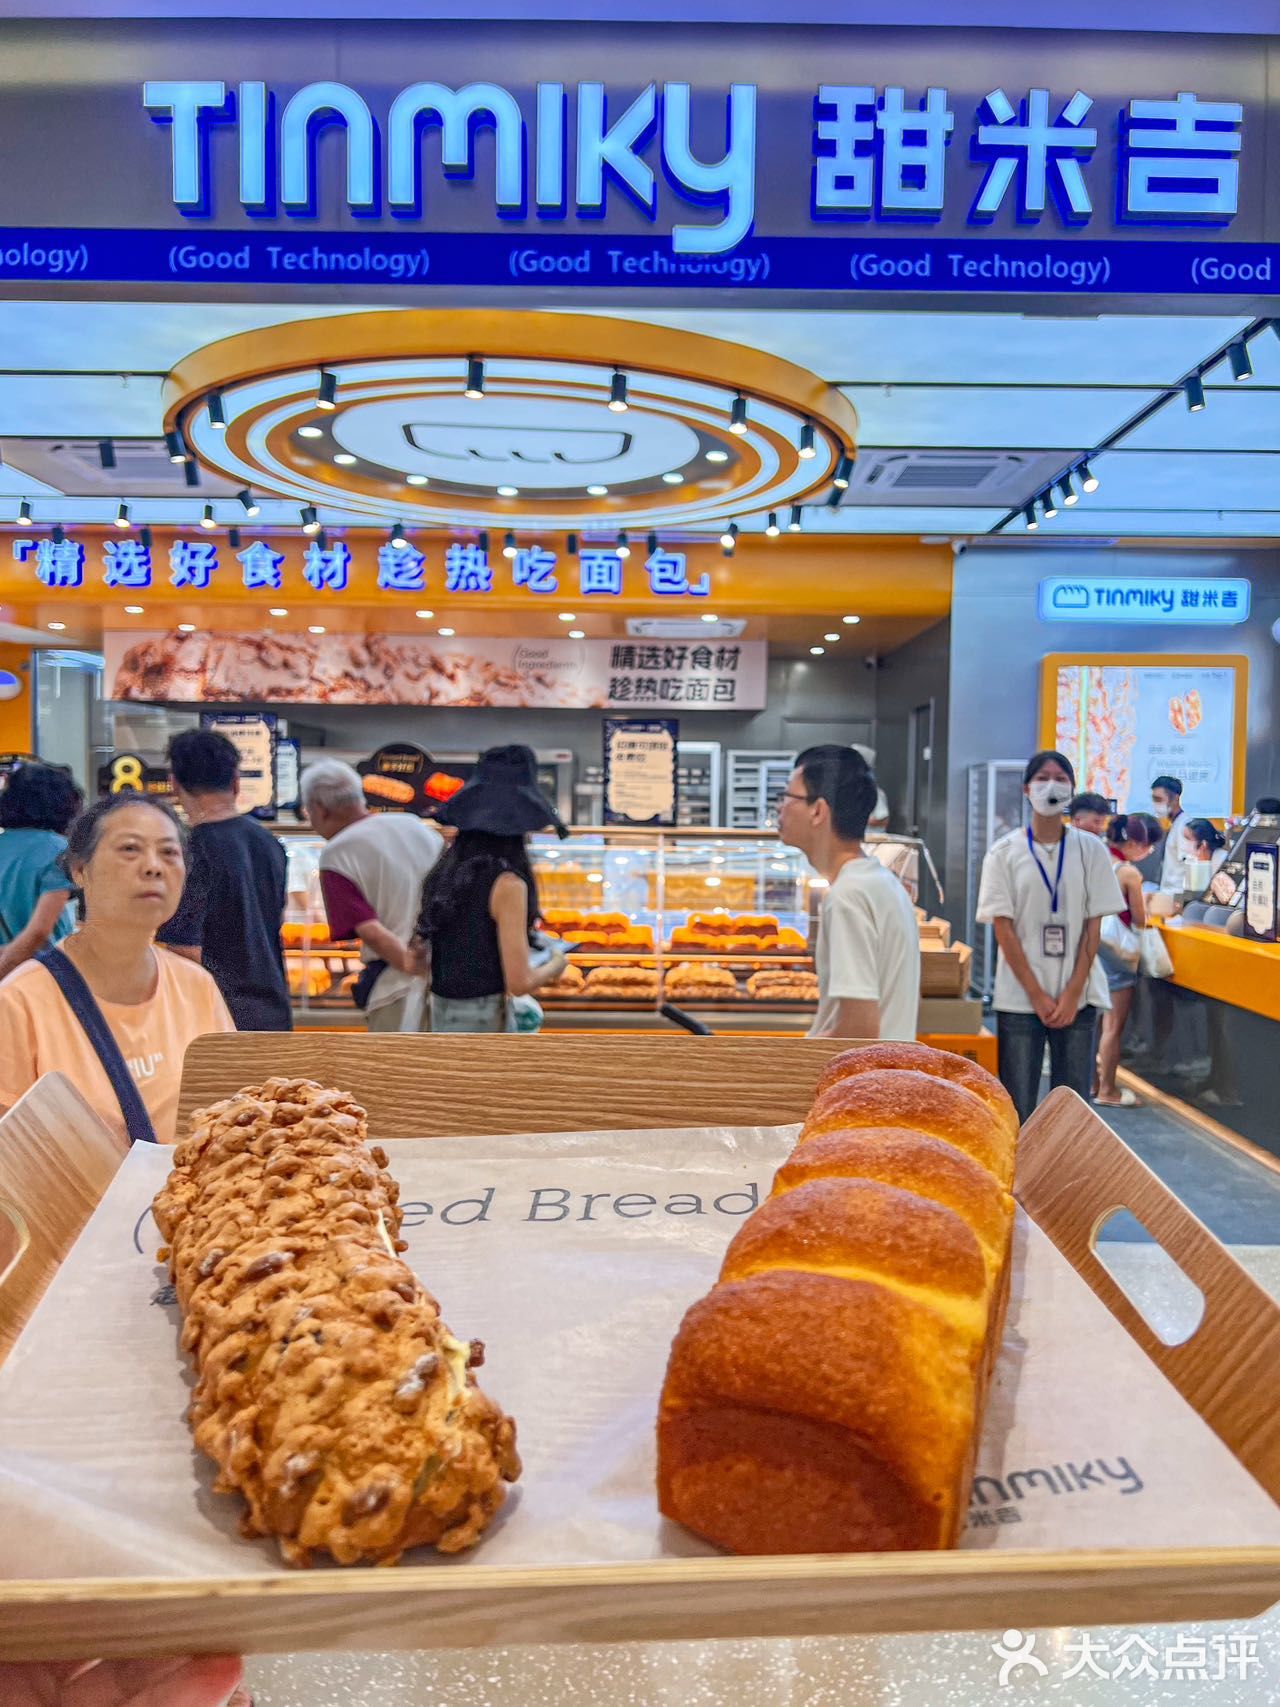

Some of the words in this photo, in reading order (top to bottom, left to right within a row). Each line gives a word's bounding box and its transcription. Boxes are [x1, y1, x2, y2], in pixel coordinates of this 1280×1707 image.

[814, 86, 1244, 214] 甜米吉
[0, 242, 88, 273] ology)
[169, 245, 250, 273] (Good
[266, 245, 429, 278] Technology)
[510, 250, 590, 277] (Good
[850, 253, 931, 281] (Good
[948, 253, 1110, 286] Technology)
[1191, 256, 1271, 285] (Good
[1181, 588, 1238, 608] 甜米吉
[610, 645, 741, 670] 精选好食材
[608, 676, 736, 702] 趁热吃面包
[522, 1183, 759, 1222] Bread
